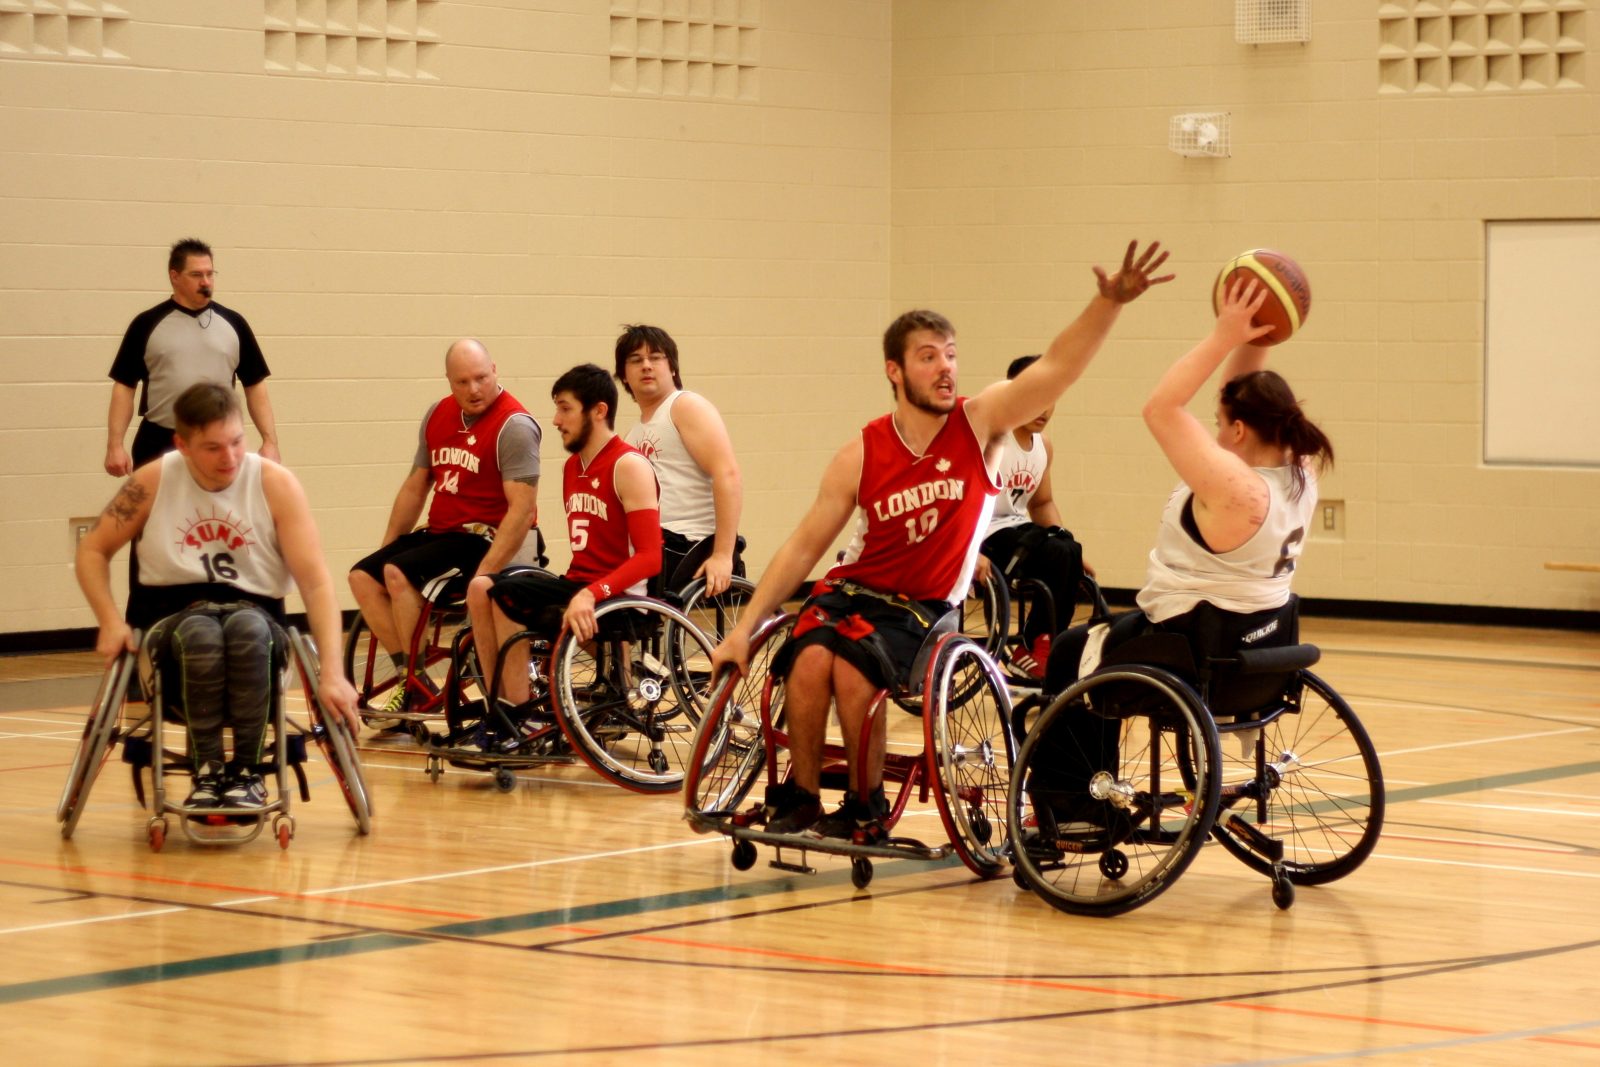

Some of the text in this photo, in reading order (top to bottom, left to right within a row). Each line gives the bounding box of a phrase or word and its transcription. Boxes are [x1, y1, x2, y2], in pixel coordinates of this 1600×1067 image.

[438, 470, 459, 494] 14
[874, 478, 964, 521] LONDON
[1011, 489, 1024, 507] 7
[186, 523, 244, 551] SUNS
[571, 519, 590, 551] 5
[905, 507, 939, 545] 10
[199, 552, 239, 583] 16
